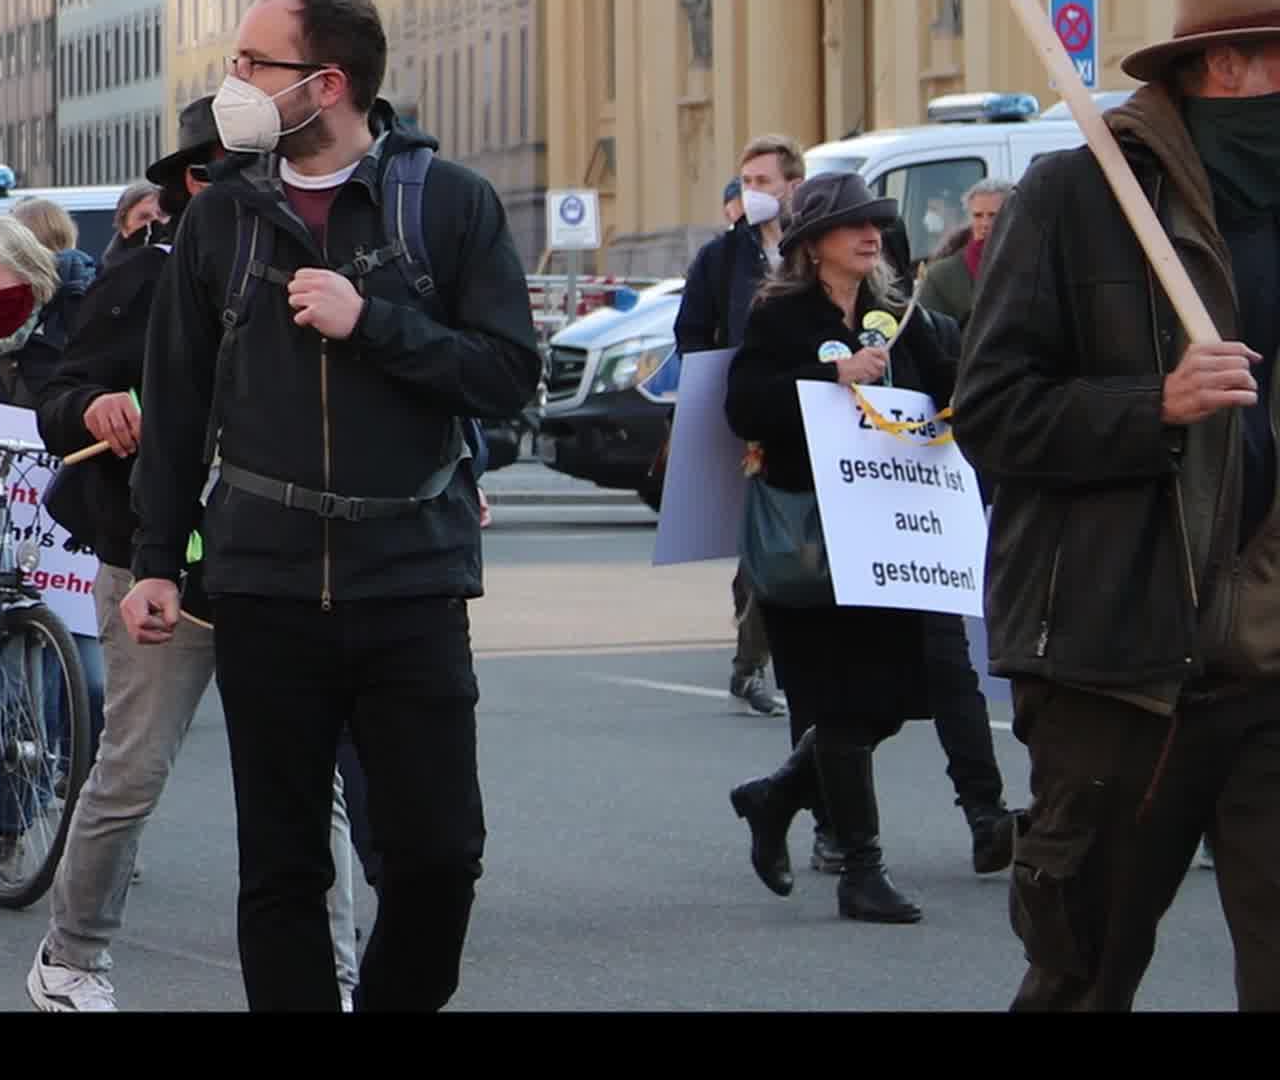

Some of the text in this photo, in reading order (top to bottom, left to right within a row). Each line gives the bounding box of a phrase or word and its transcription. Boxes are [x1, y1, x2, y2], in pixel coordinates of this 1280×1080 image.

[840, 457, 965, 493] geschützt ist
[895, 510, 943, 535] auch
[872, 561, 976, 591] gestorben!
